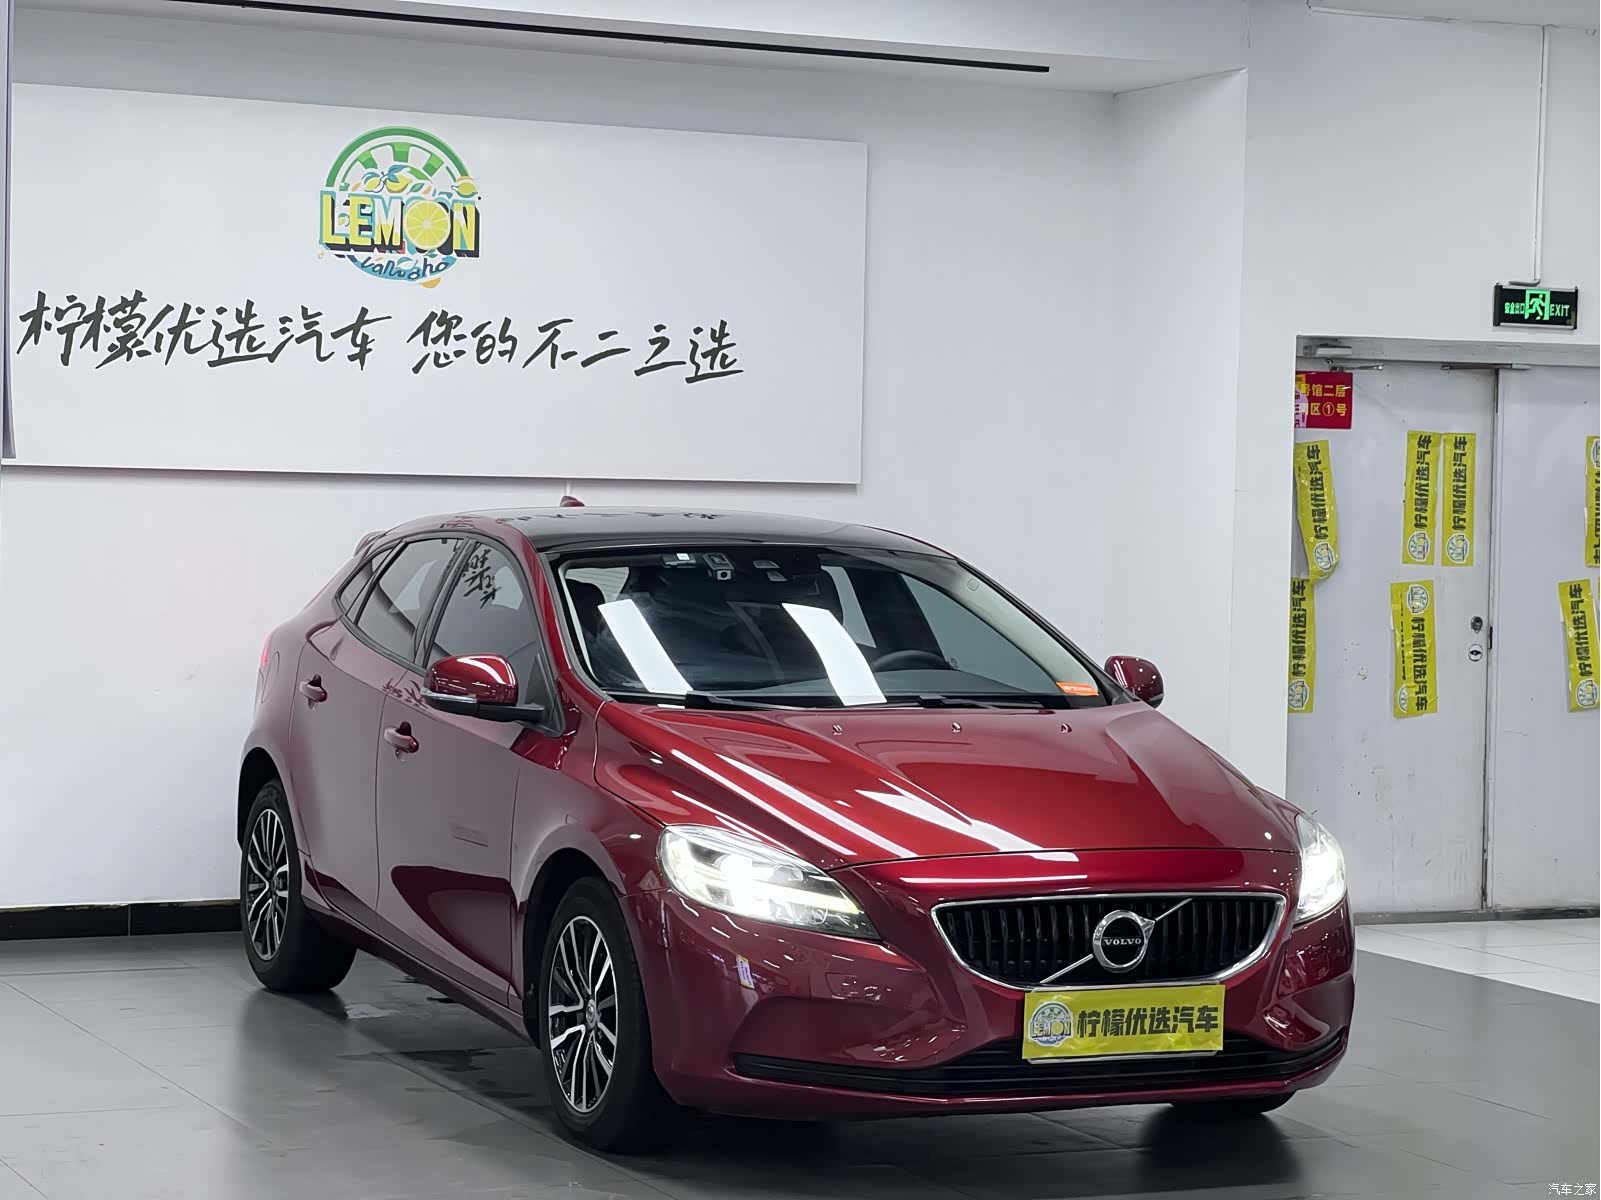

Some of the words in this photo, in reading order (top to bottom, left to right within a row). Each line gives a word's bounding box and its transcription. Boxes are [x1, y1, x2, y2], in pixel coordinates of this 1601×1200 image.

[319, 190, 480, 258] LEMON
[16, 289, 392, 371] 柠檬优选汽车
[406, 309, 744, 384] 您的不二之选
[1550, 303, 1570, 316] EXIT
[1307, 444, 1328, 540] 柠檬优选汽车
[1414, 434, 1432, 529] 柠檬优选汽车
[1452, 435, 1467, 531] 柠檬优选汽车
[1031, 1019, 1072, 1039] LEMON
[1077, 1005, 1219, 1038] 柠檬优选汽车
